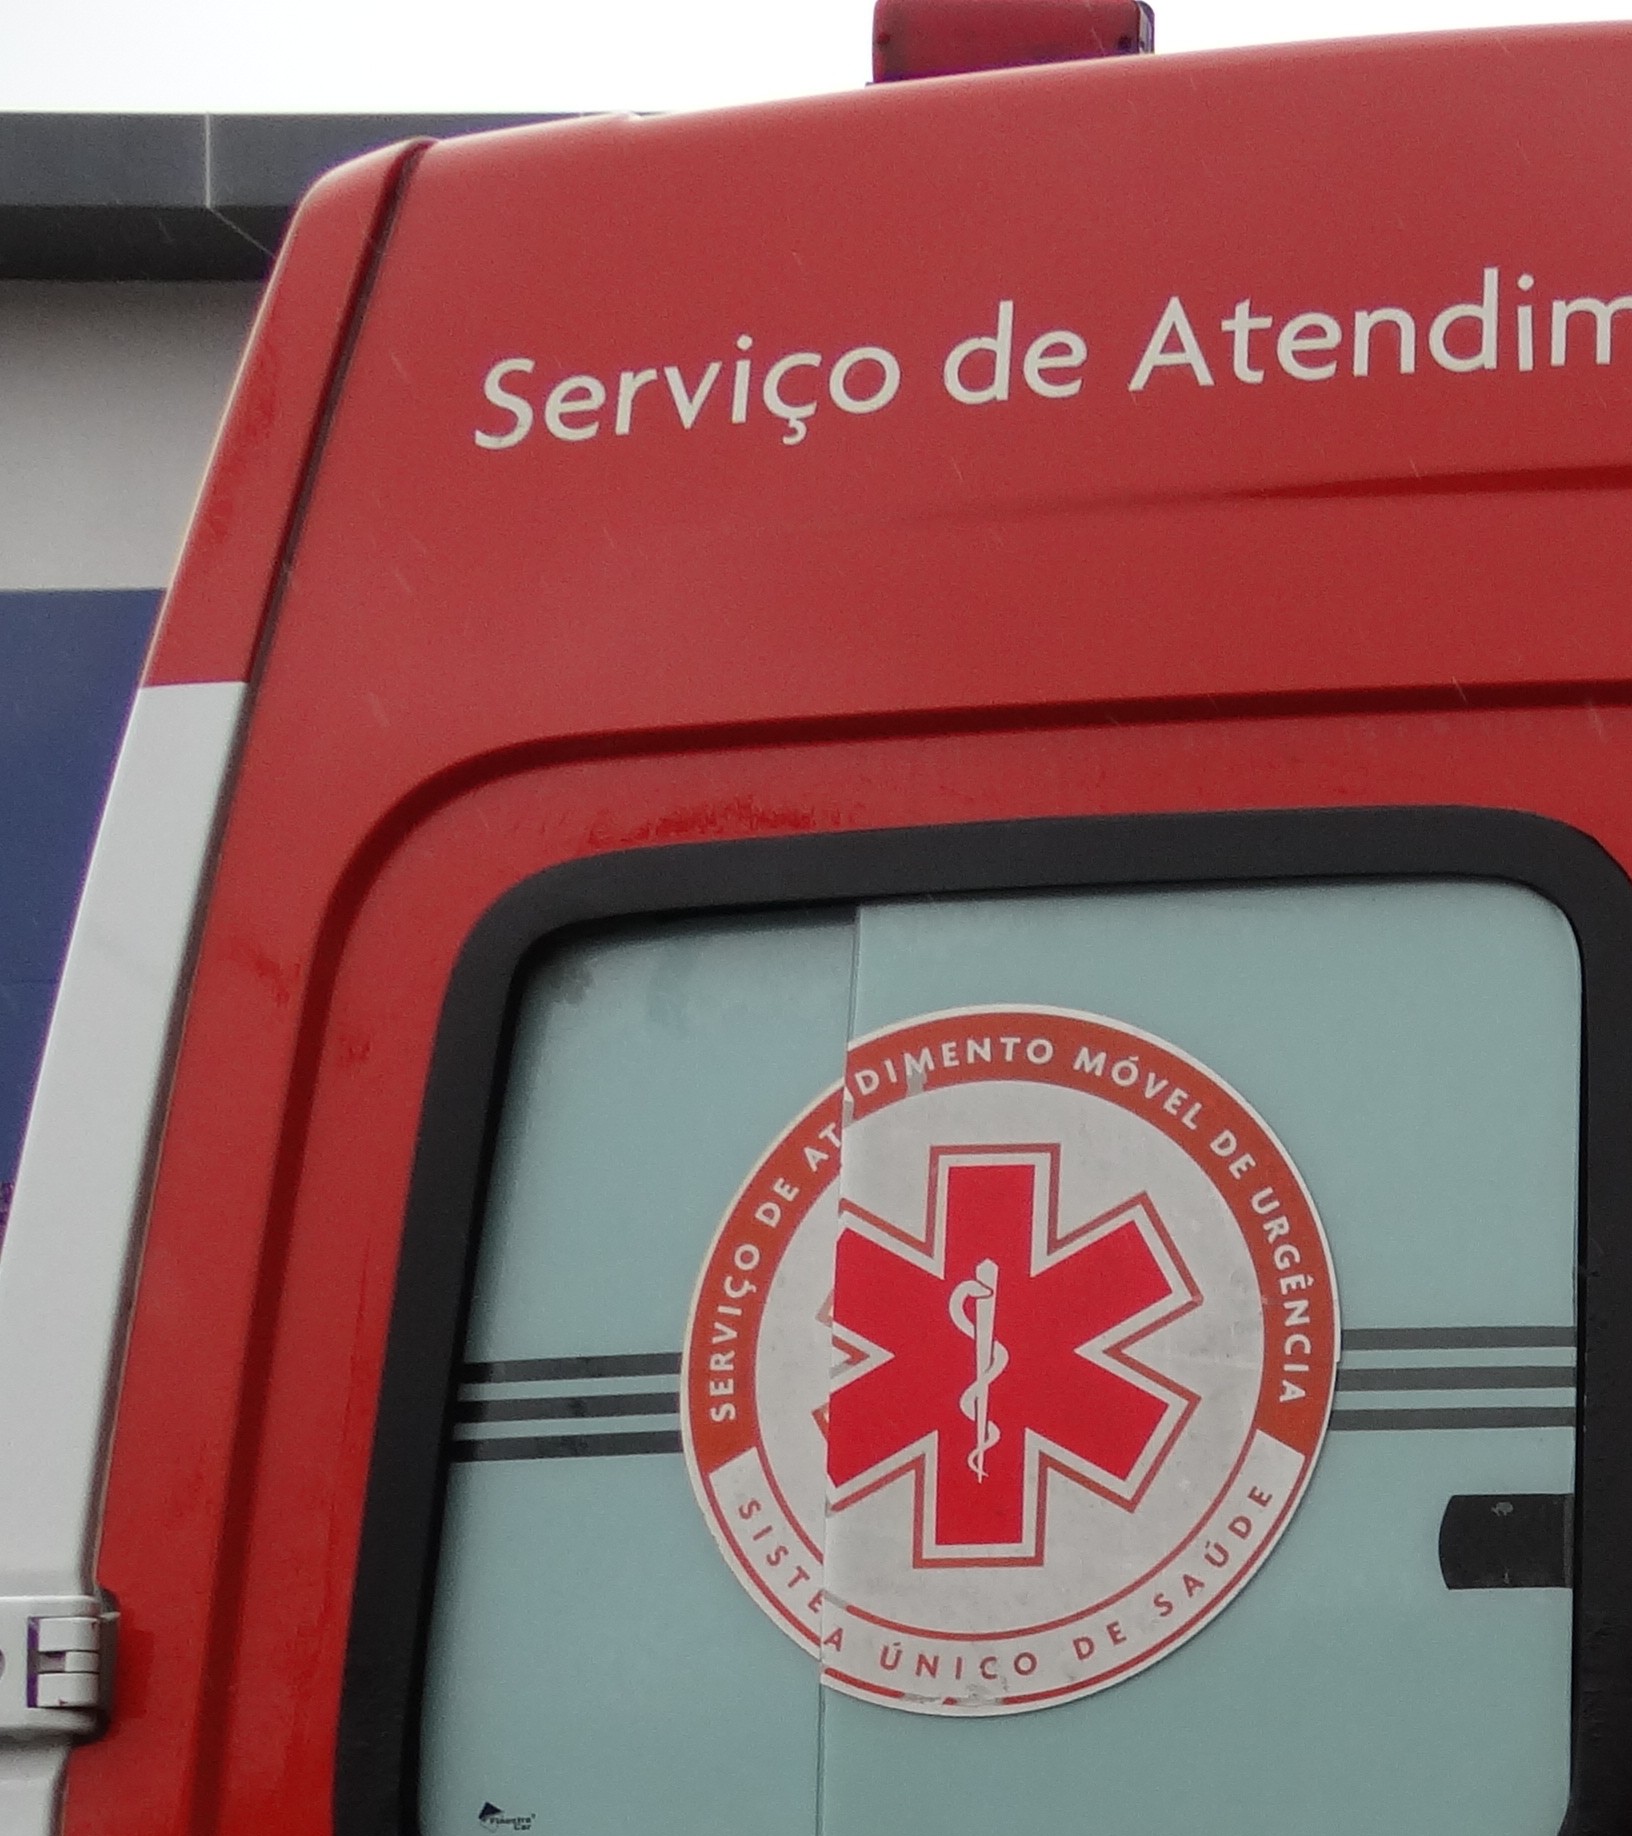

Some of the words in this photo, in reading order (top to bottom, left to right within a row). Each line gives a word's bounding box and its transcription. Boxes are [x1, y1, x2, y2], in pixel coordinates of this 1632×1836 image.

[474, 332, 900, 445] Serviço
[943, 301, 1088, 404] de
[710, 1243, 760, 1422] SERVIÇO
[755, 1176, 799, 1228] DE
[1073, 1047, 1202, 1131] MÓVEL
[1210, 1129, 1257, 1181] DE
[1251, 1187, 1315, 1404] URGÊNCIA
[880, 1641, 1038, 1681] ÚNICO
[1072, 1620, 1127, 1661] DE
[1152, 1485, 1273, 1617] SAÚDE
